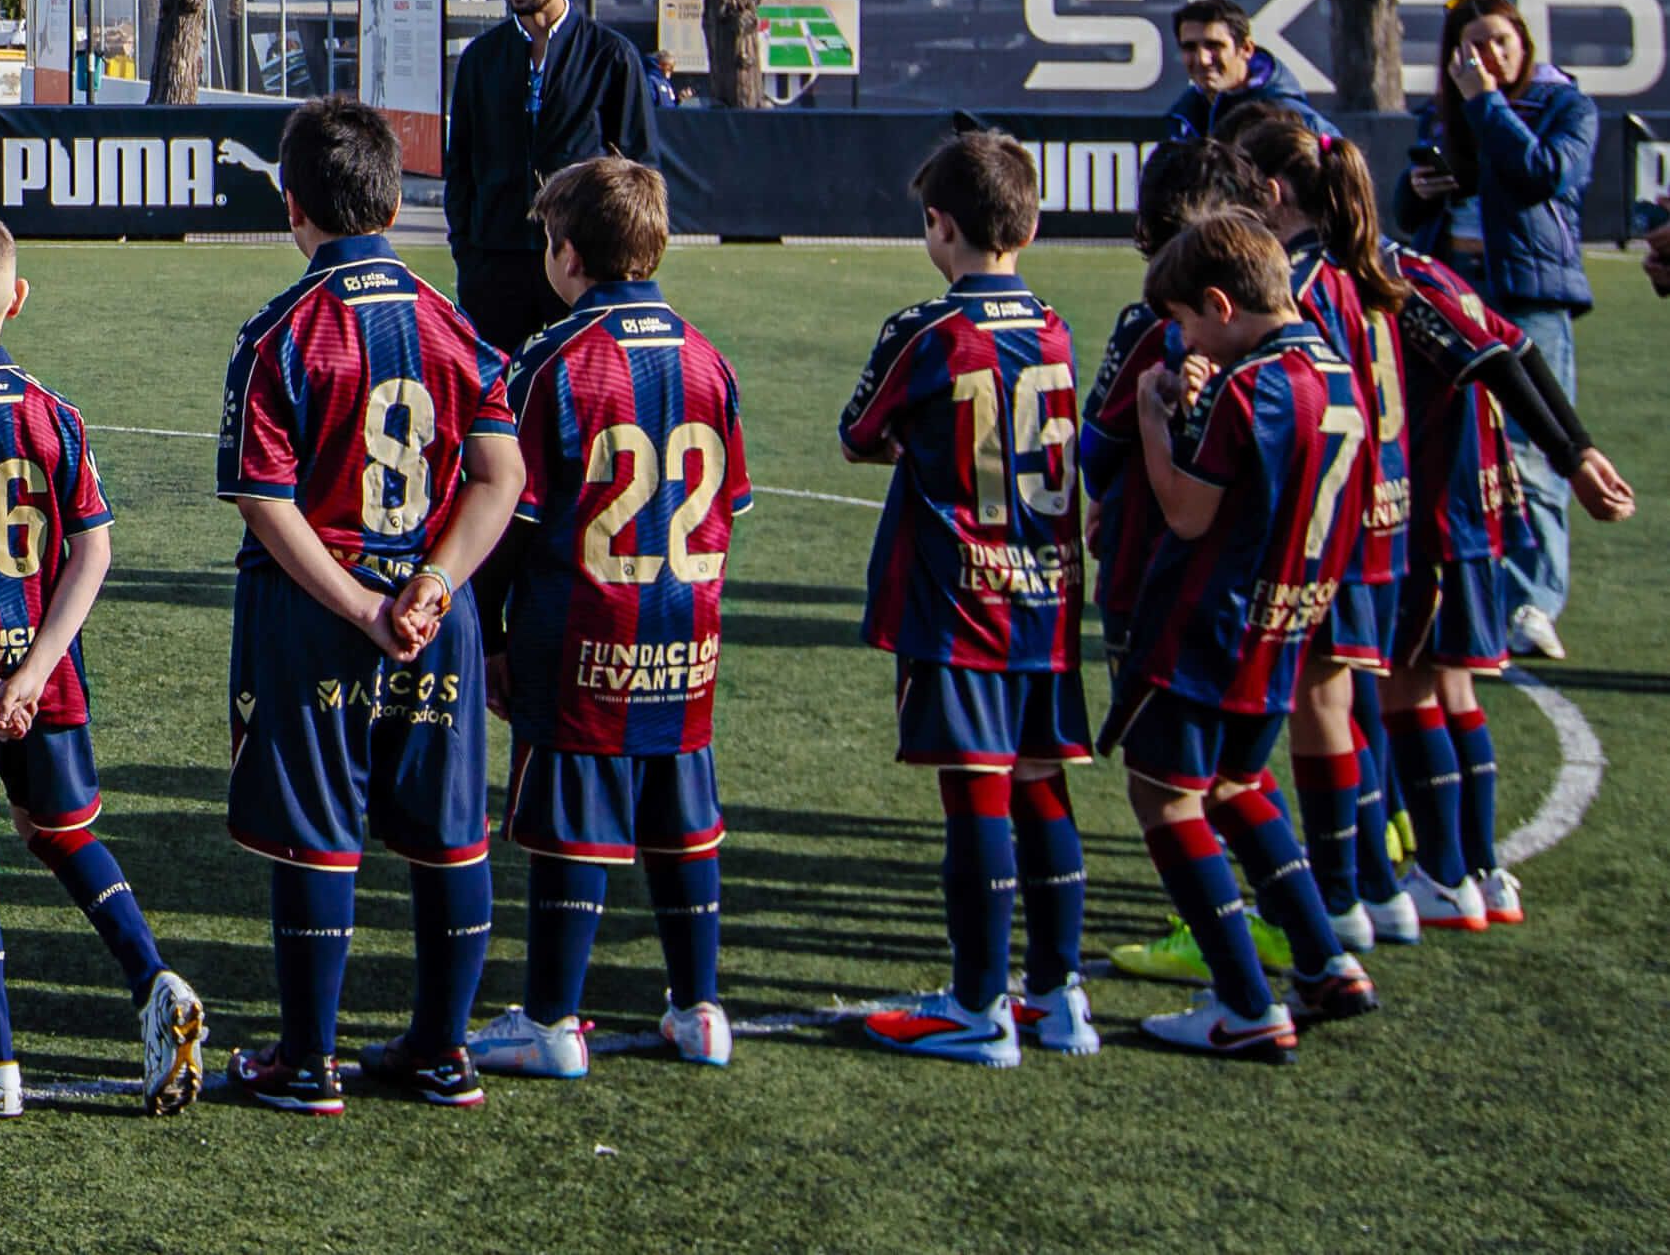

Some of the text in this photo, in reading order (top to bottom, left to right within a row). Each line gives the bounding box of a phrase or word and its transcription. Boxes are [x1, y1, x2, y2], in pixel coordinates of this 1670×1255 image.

[2, 137, 214, 206] PUMA
[1019, 142, 1159, 212] UM
[362, 378, 435, 536] 8
[584, 421, 727, 584] 22
[952, 362, 1076, 526] 15
[1304, 405, 1365, 559] 7
